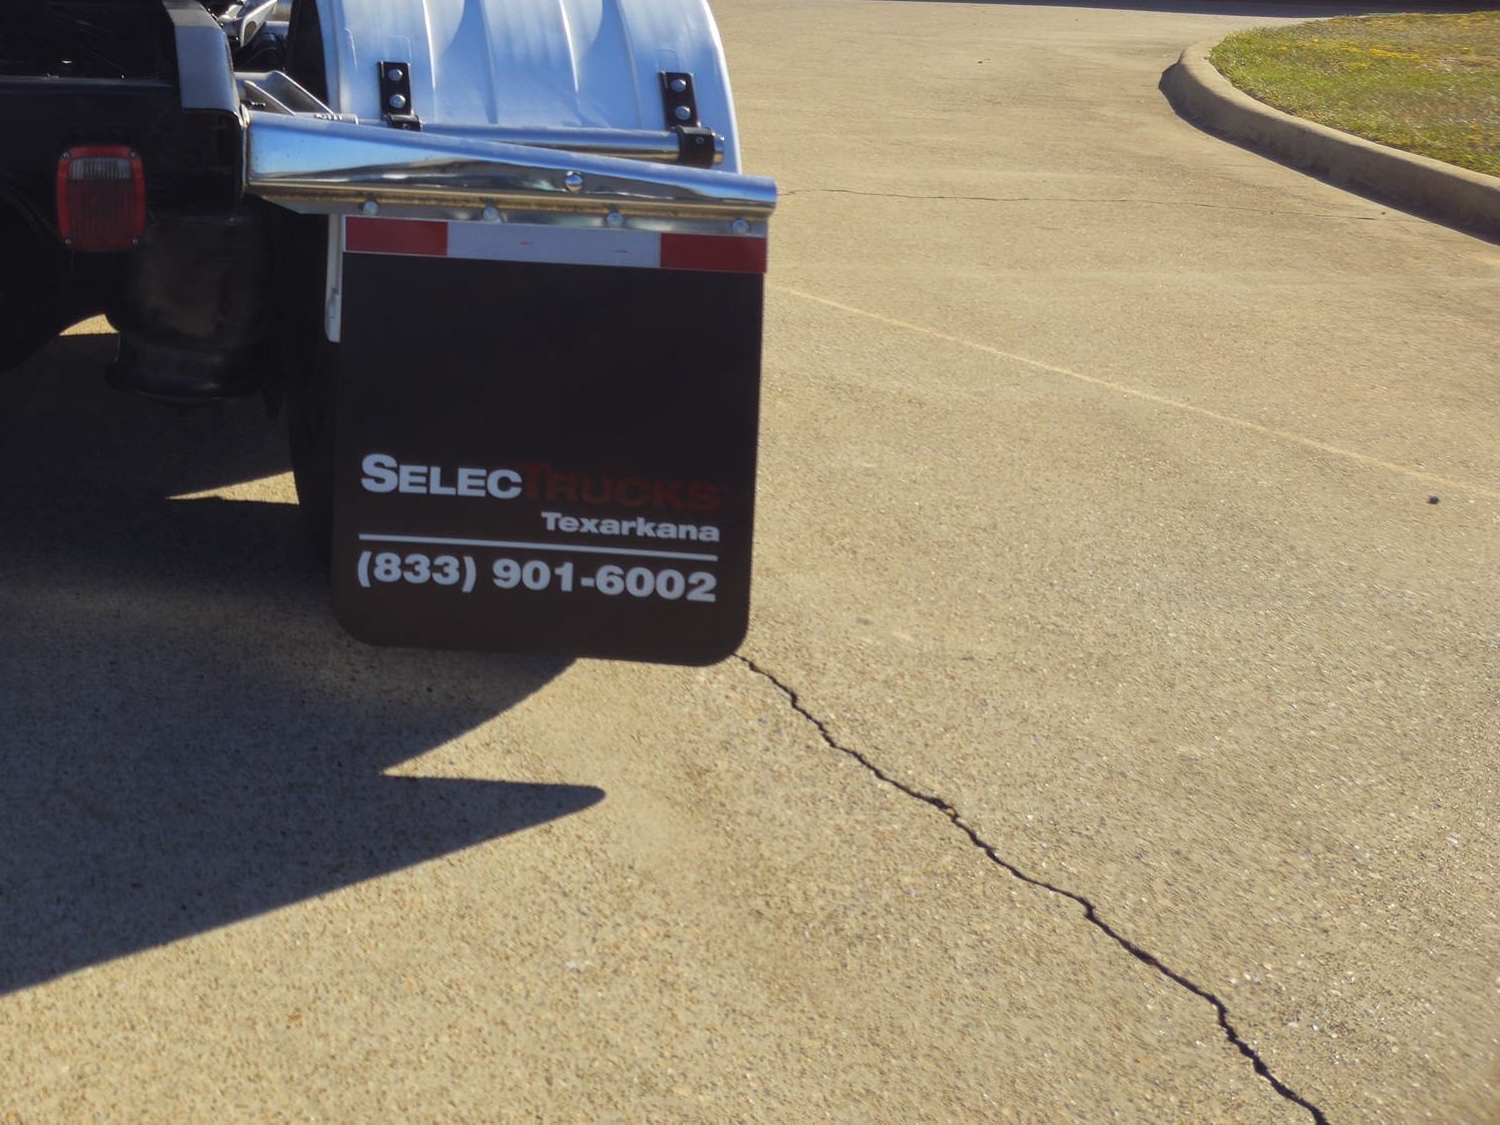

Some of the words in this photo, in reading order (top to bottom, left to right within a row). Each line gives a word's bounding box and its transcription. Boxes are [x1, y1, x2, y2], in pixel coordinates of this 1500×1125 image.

[540, 511, 720, 542] Texarkana
[357, 550, 477, 593] (833)
[492, 558, 717, 603] 901-6002
